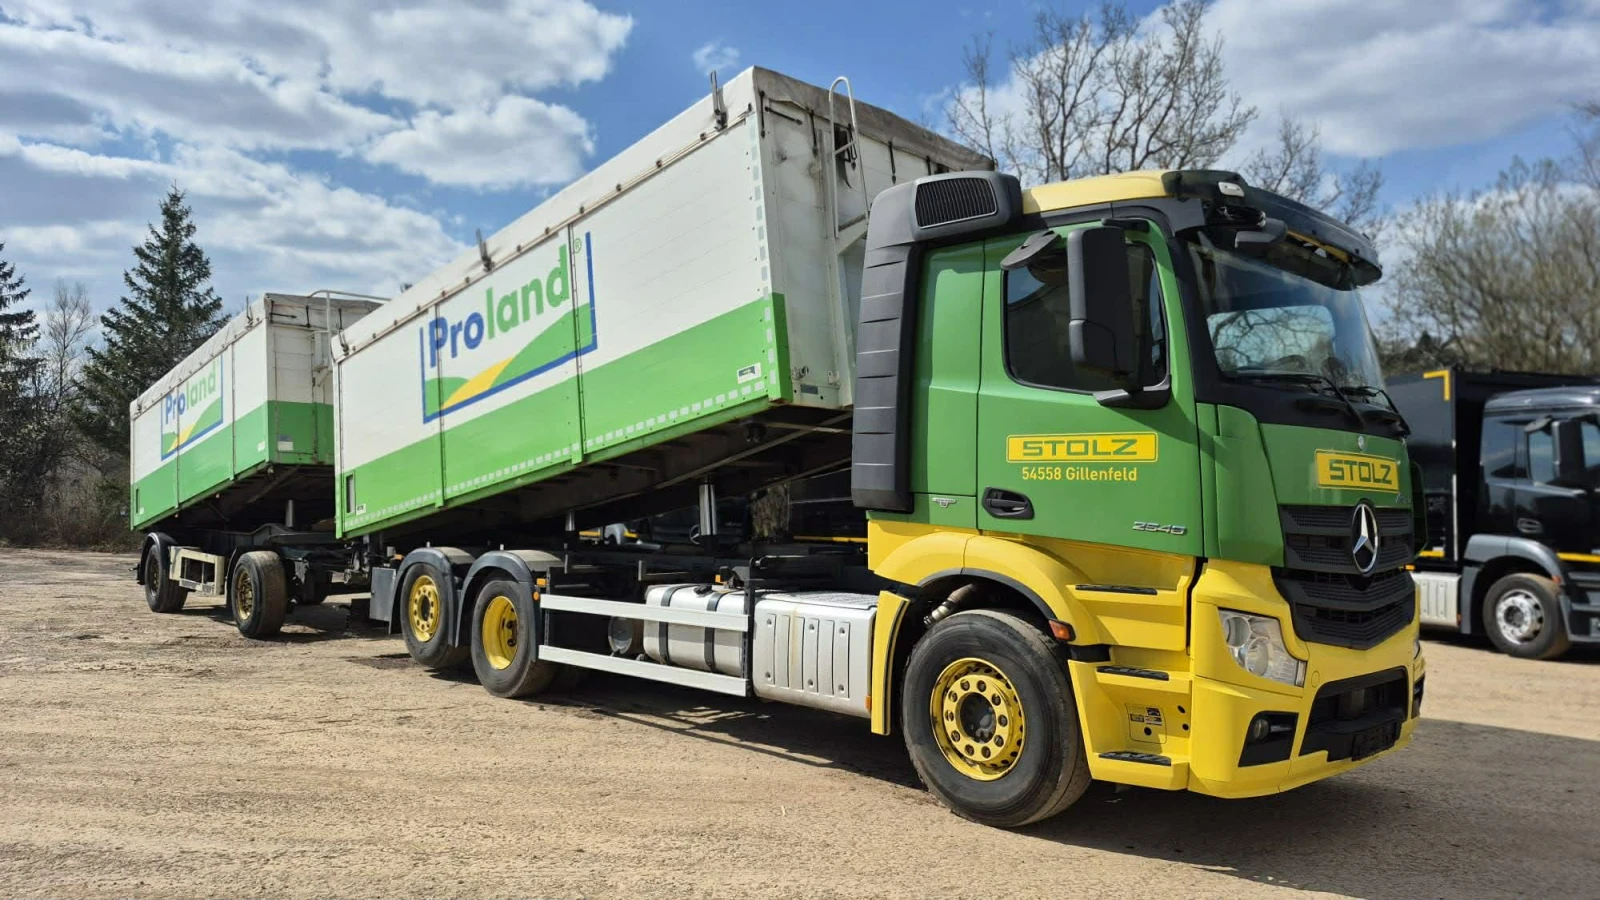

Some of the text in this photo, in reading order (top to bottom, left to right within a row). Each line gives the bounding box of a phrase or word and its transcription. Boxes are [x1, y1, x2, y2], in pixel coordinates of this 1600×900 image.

[429, 244, 570, 368] Proland
[164, 359, 217, 425] Proland
[1022, 438, 1138, 457] STOLZ
[1021, 466, 1138, 481] 54558 Gillenfeld
[1329, 459, 1393, 485] STOLZ
